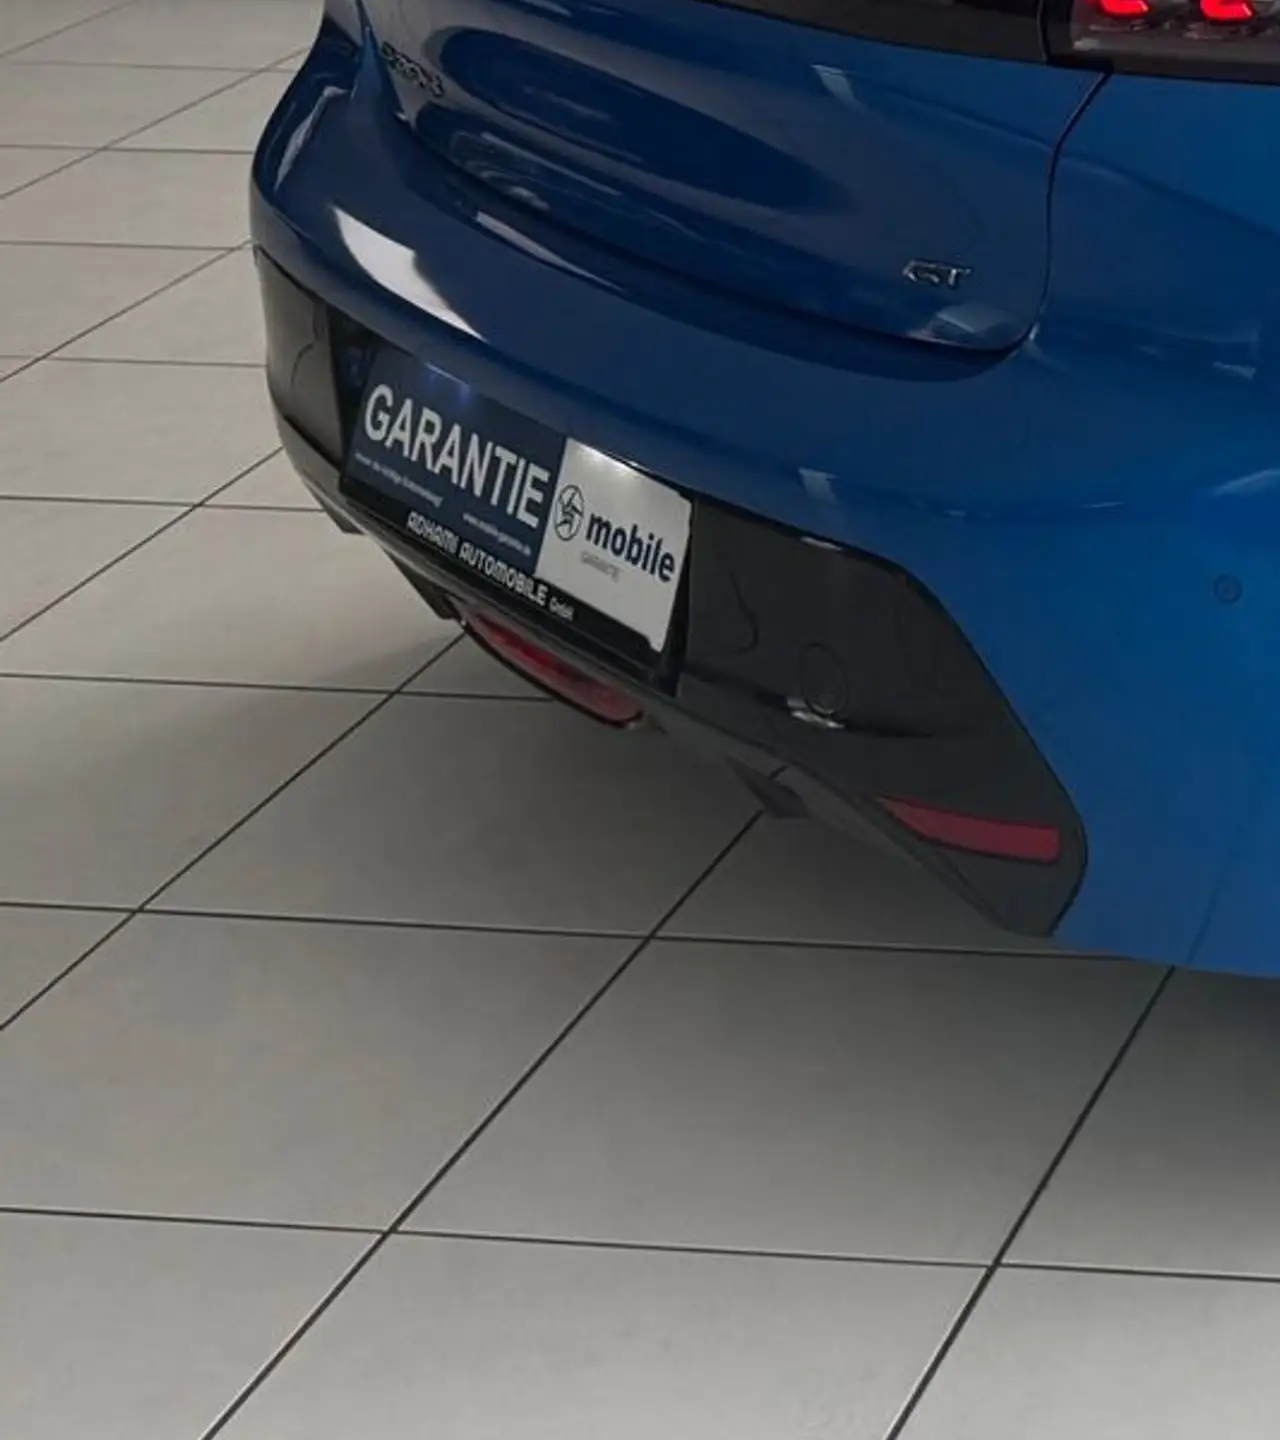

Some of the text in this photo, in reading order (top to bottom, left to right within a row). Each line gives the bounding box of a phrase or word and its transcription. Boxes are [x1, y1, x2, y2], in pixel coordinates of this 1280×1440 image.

[364, 384, 551, 529] GARANTIE
[458, 542, 549, 606] AUTOMOBILE
[585, 512, 675, 583] mobile
